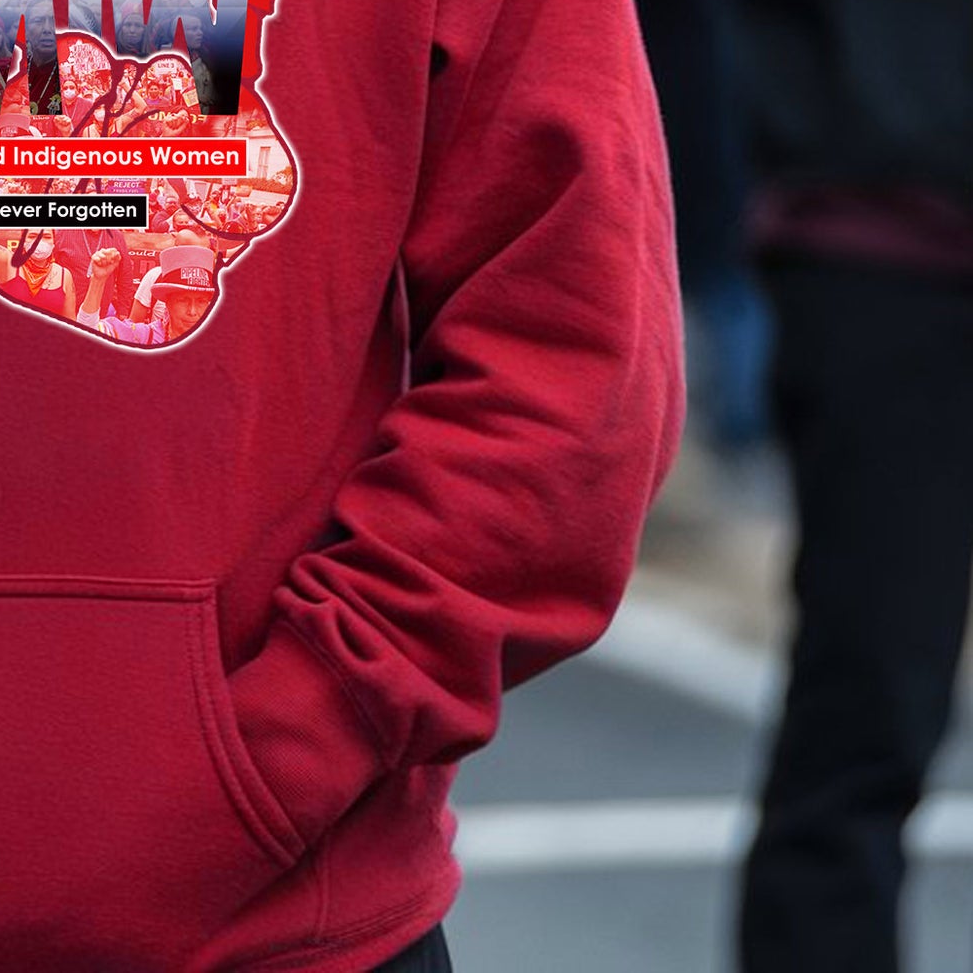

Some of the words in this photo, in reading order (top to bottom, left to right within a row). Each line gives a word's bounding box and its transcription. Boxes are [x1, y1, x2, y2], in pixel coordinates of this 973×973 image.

[14, 145, 143, 170] Indigenous
[149, 146, 240, 166] Women
[113, 181, 140, 189] REJECT
[48, 201, 137, 222] Forgotten
